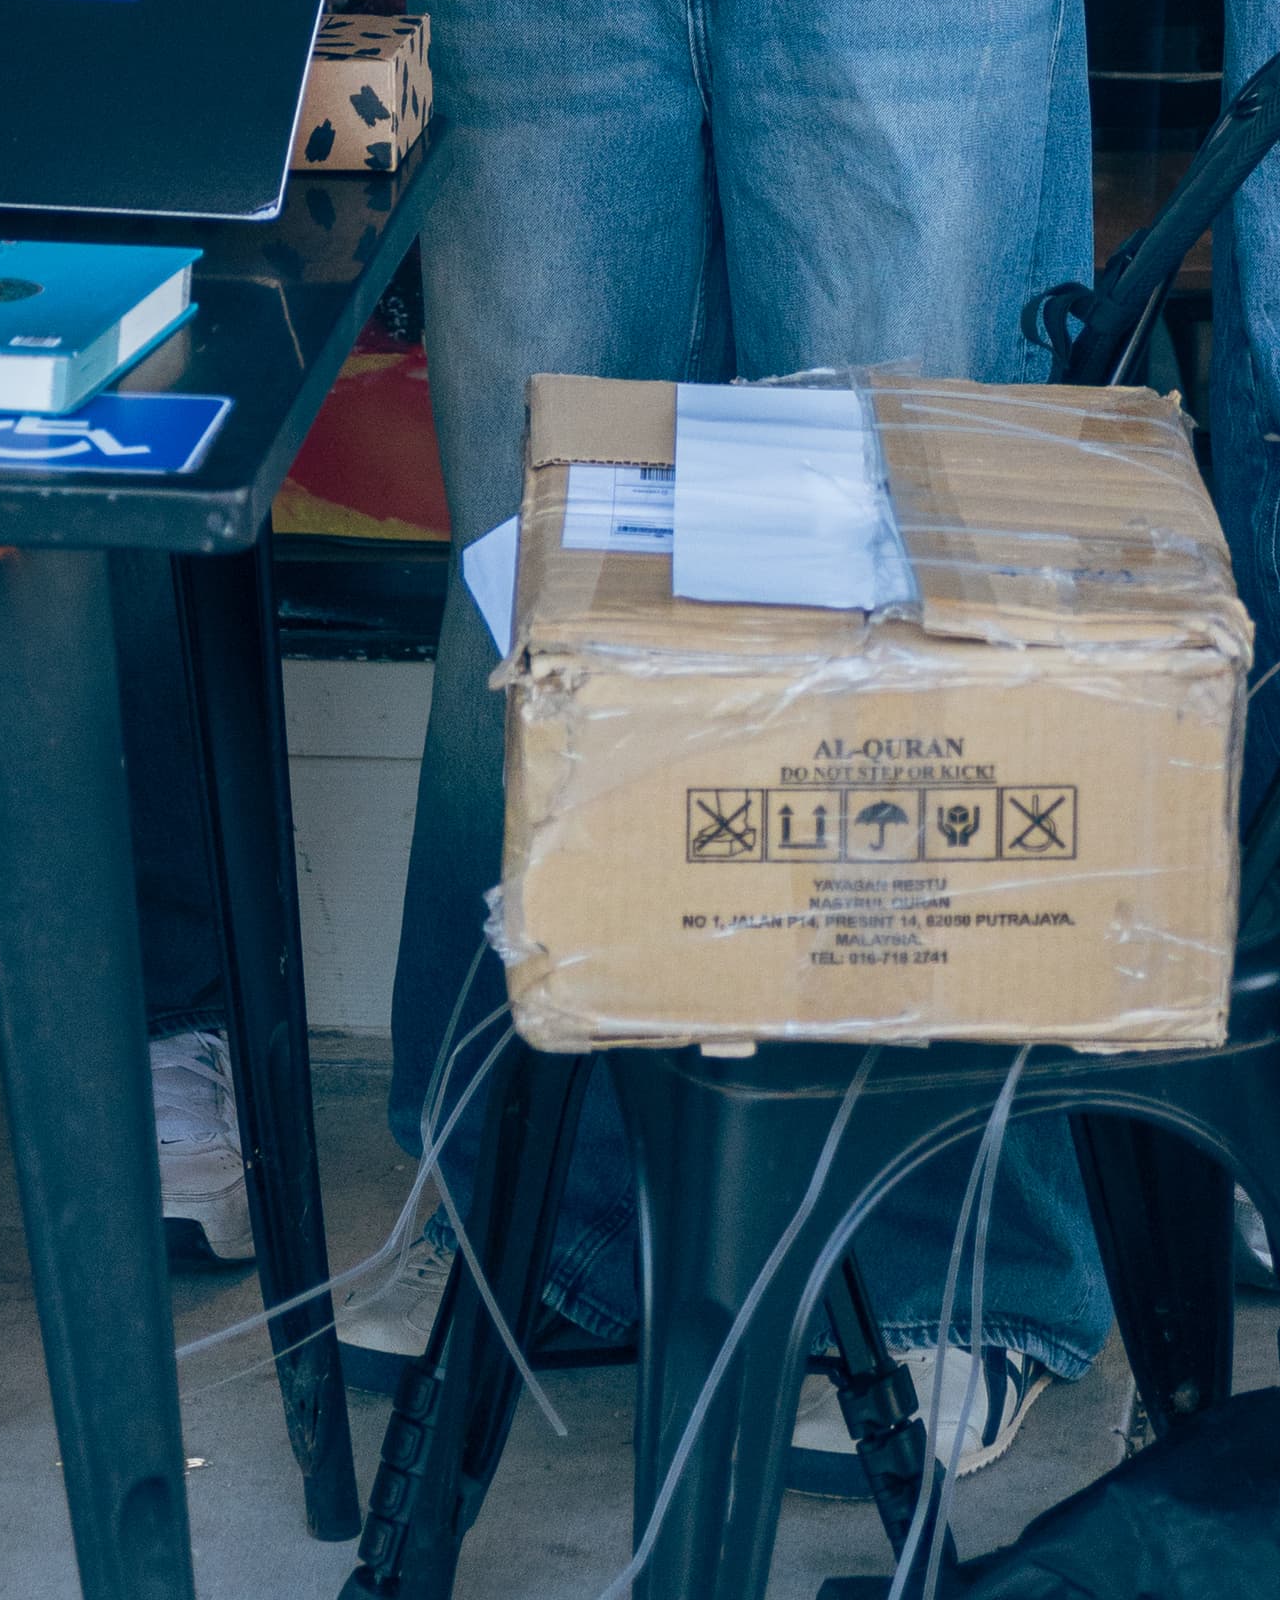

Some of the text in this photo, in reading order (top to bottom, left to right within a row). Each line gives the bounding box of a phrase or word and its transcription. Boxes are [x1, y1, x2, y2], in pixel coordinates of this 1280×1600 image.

[813, 737, 964, 763] AL-QURAN
[781, 766, 808, 782] DO
[813, 766, 853, 781] NOT
[682, 915, 707, 929] NO
